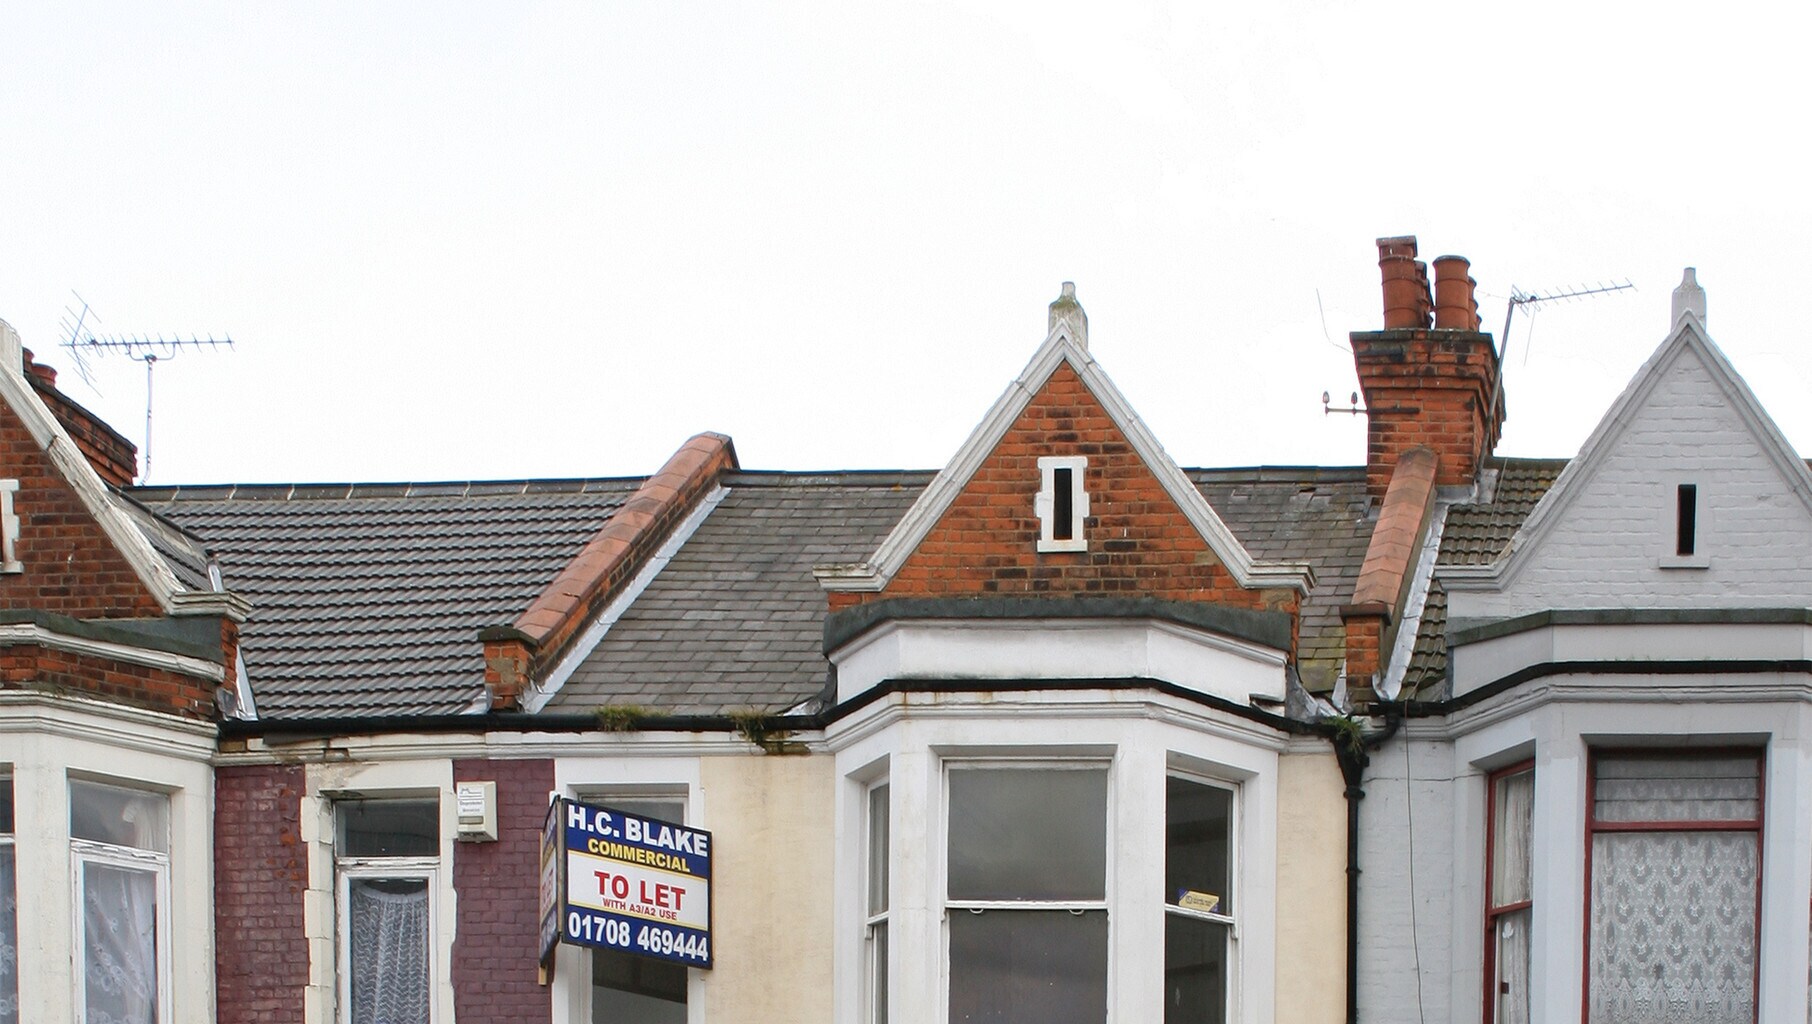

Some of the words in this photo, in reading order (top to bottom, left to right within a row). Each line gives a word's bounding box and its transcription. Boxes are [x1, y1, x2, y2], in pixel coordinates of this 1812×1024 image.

[568, 804, 620, 838] H.C.
[625, 817, 708, 858] BLAKE
[588, 838, 691, 873] COMMERCIAL
[594, 870, 629, 899] TO
[640, 881, 686, 911] LET
[603, 898, 626, 911] WITH
[629, 904, 656, 916] A3/A2
[659, 910, 678, 921] USE
[568, 912, 630, 947] 01708
[638, 926, 708, 961] 469444
